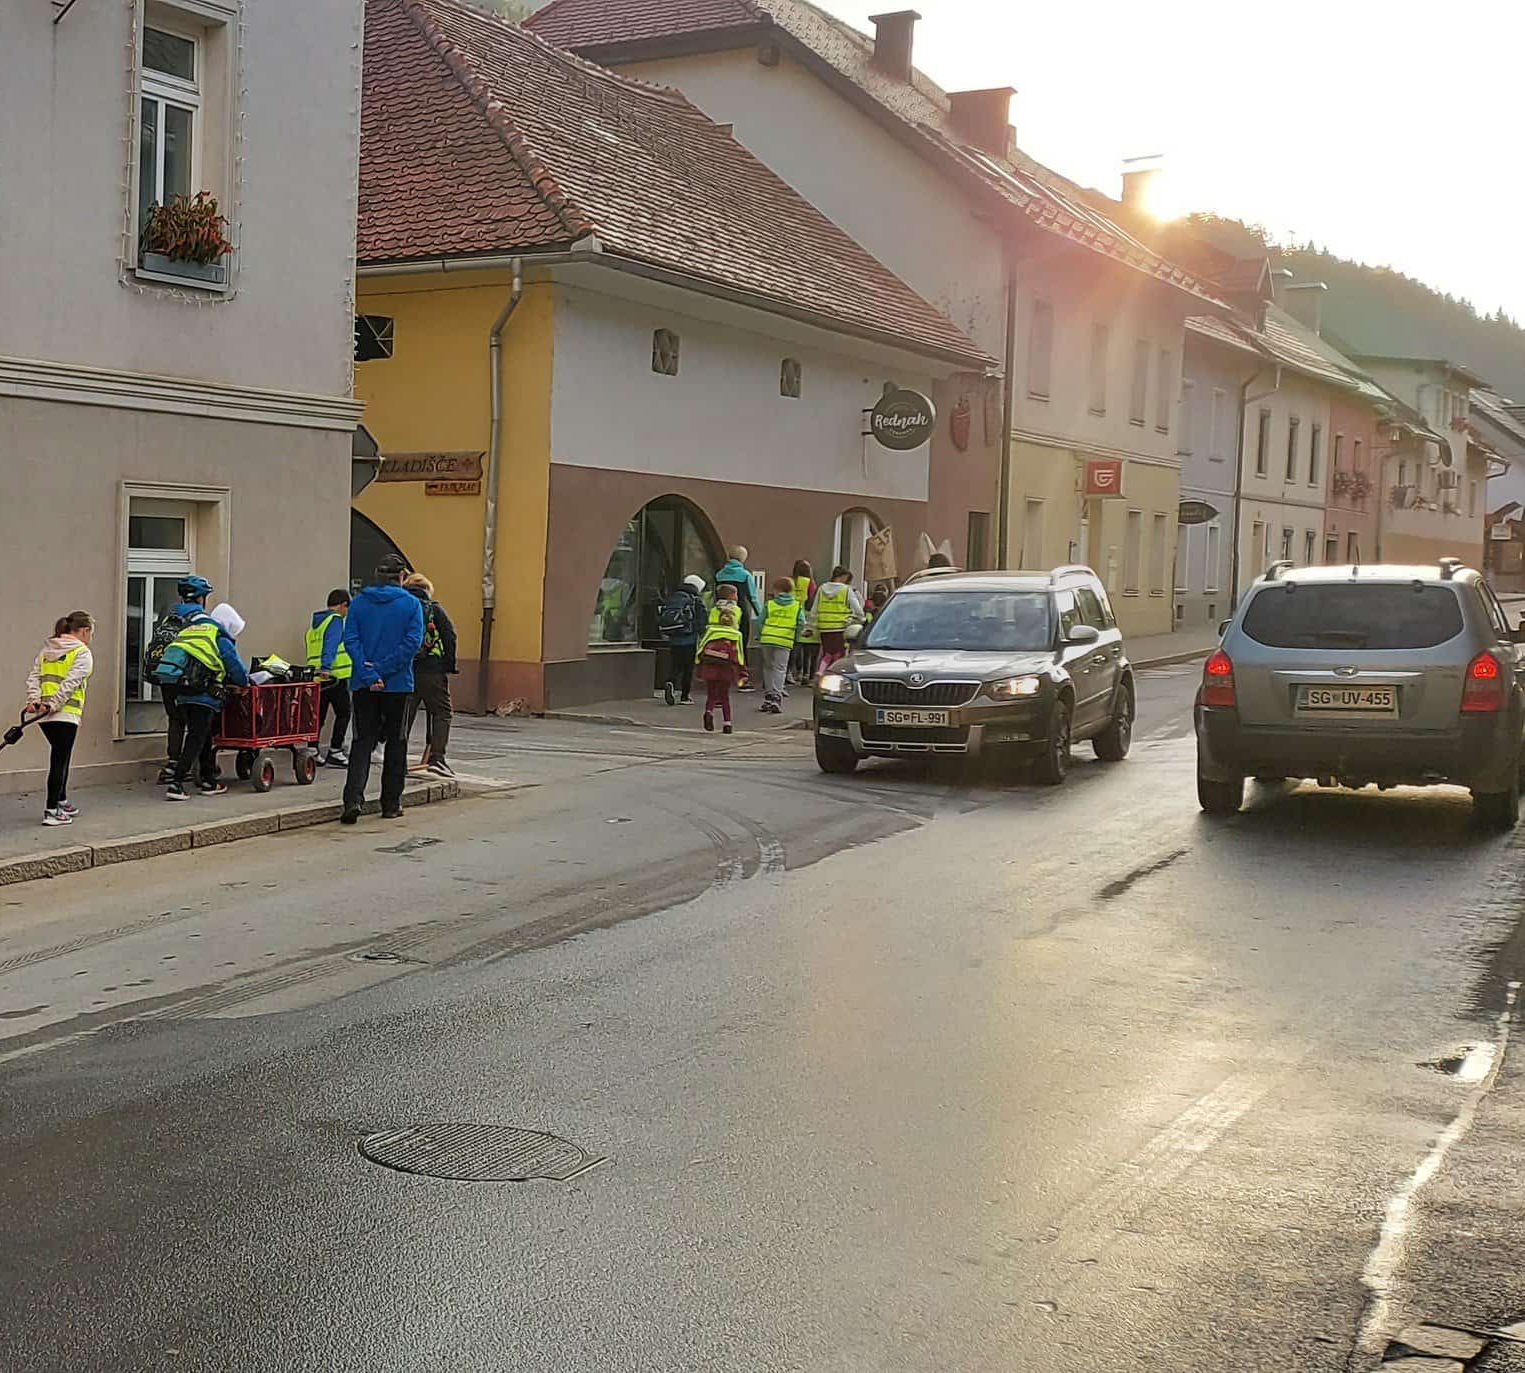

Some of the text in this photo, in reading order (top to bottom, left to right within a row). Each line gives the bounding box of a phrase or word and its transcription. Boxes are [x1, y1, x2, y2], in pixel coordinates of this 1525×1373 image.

[1311, 691, 1391, 705] SG UV-455
[887, 712, 946, 724] SG FL-991
